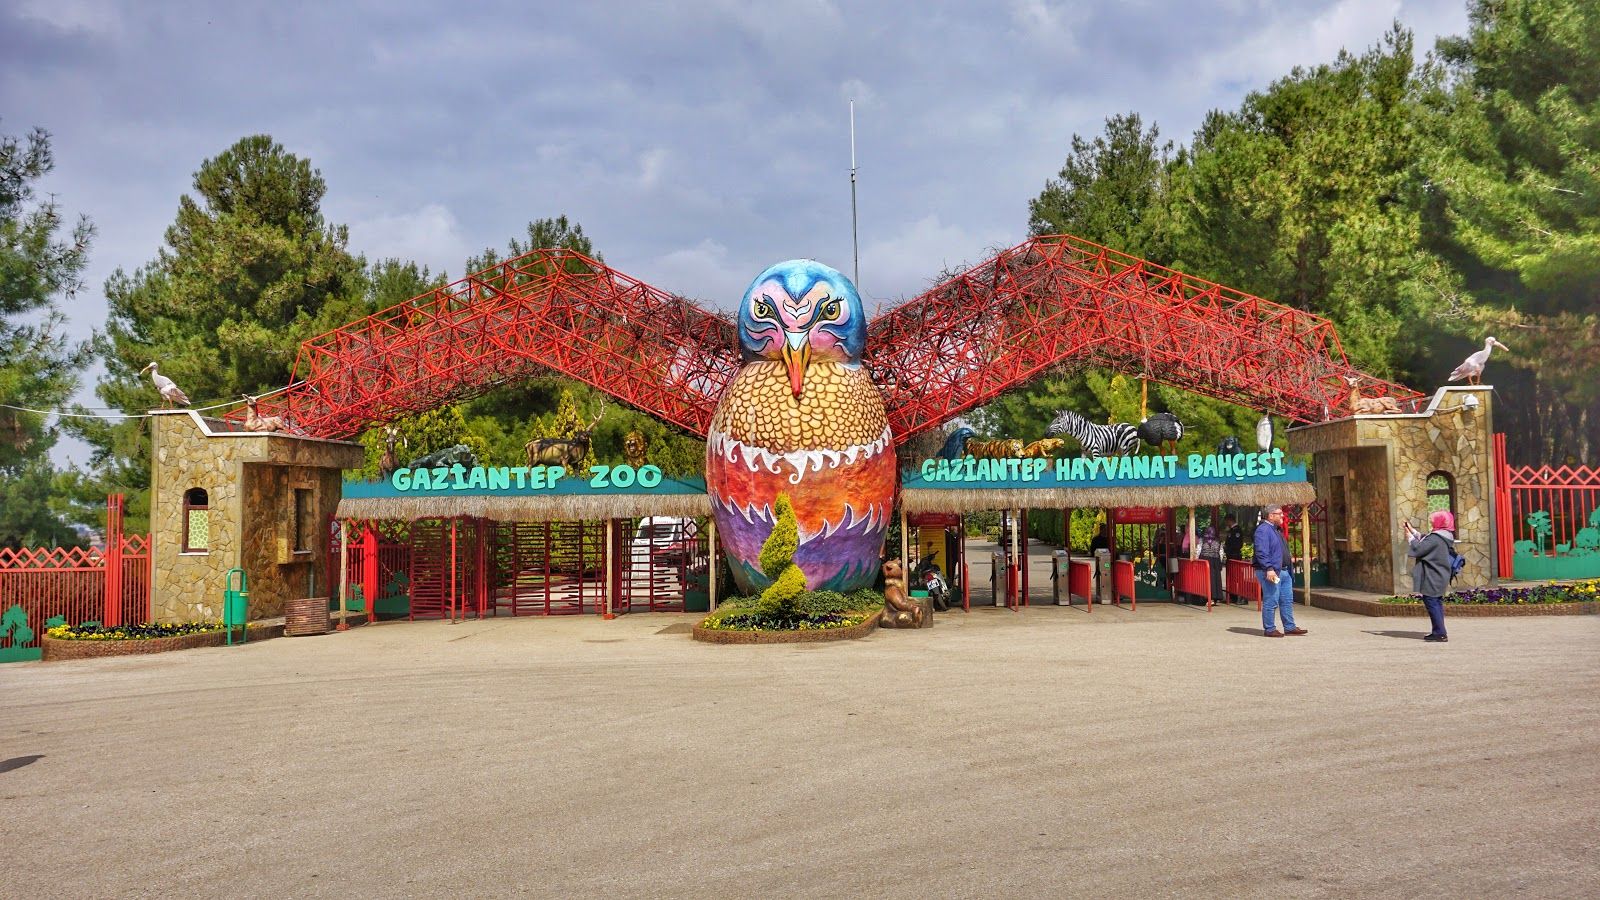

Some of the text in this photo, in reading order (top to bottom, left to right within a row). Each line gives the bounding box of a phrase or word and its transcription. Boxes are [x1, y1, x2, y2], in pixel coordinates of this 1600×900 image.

[392, 463, 662, 491] GAZİANTEP ZOO
[922, 447, 1286, 482] GAZİANTEP HAYVANAT BAHÇESİ
